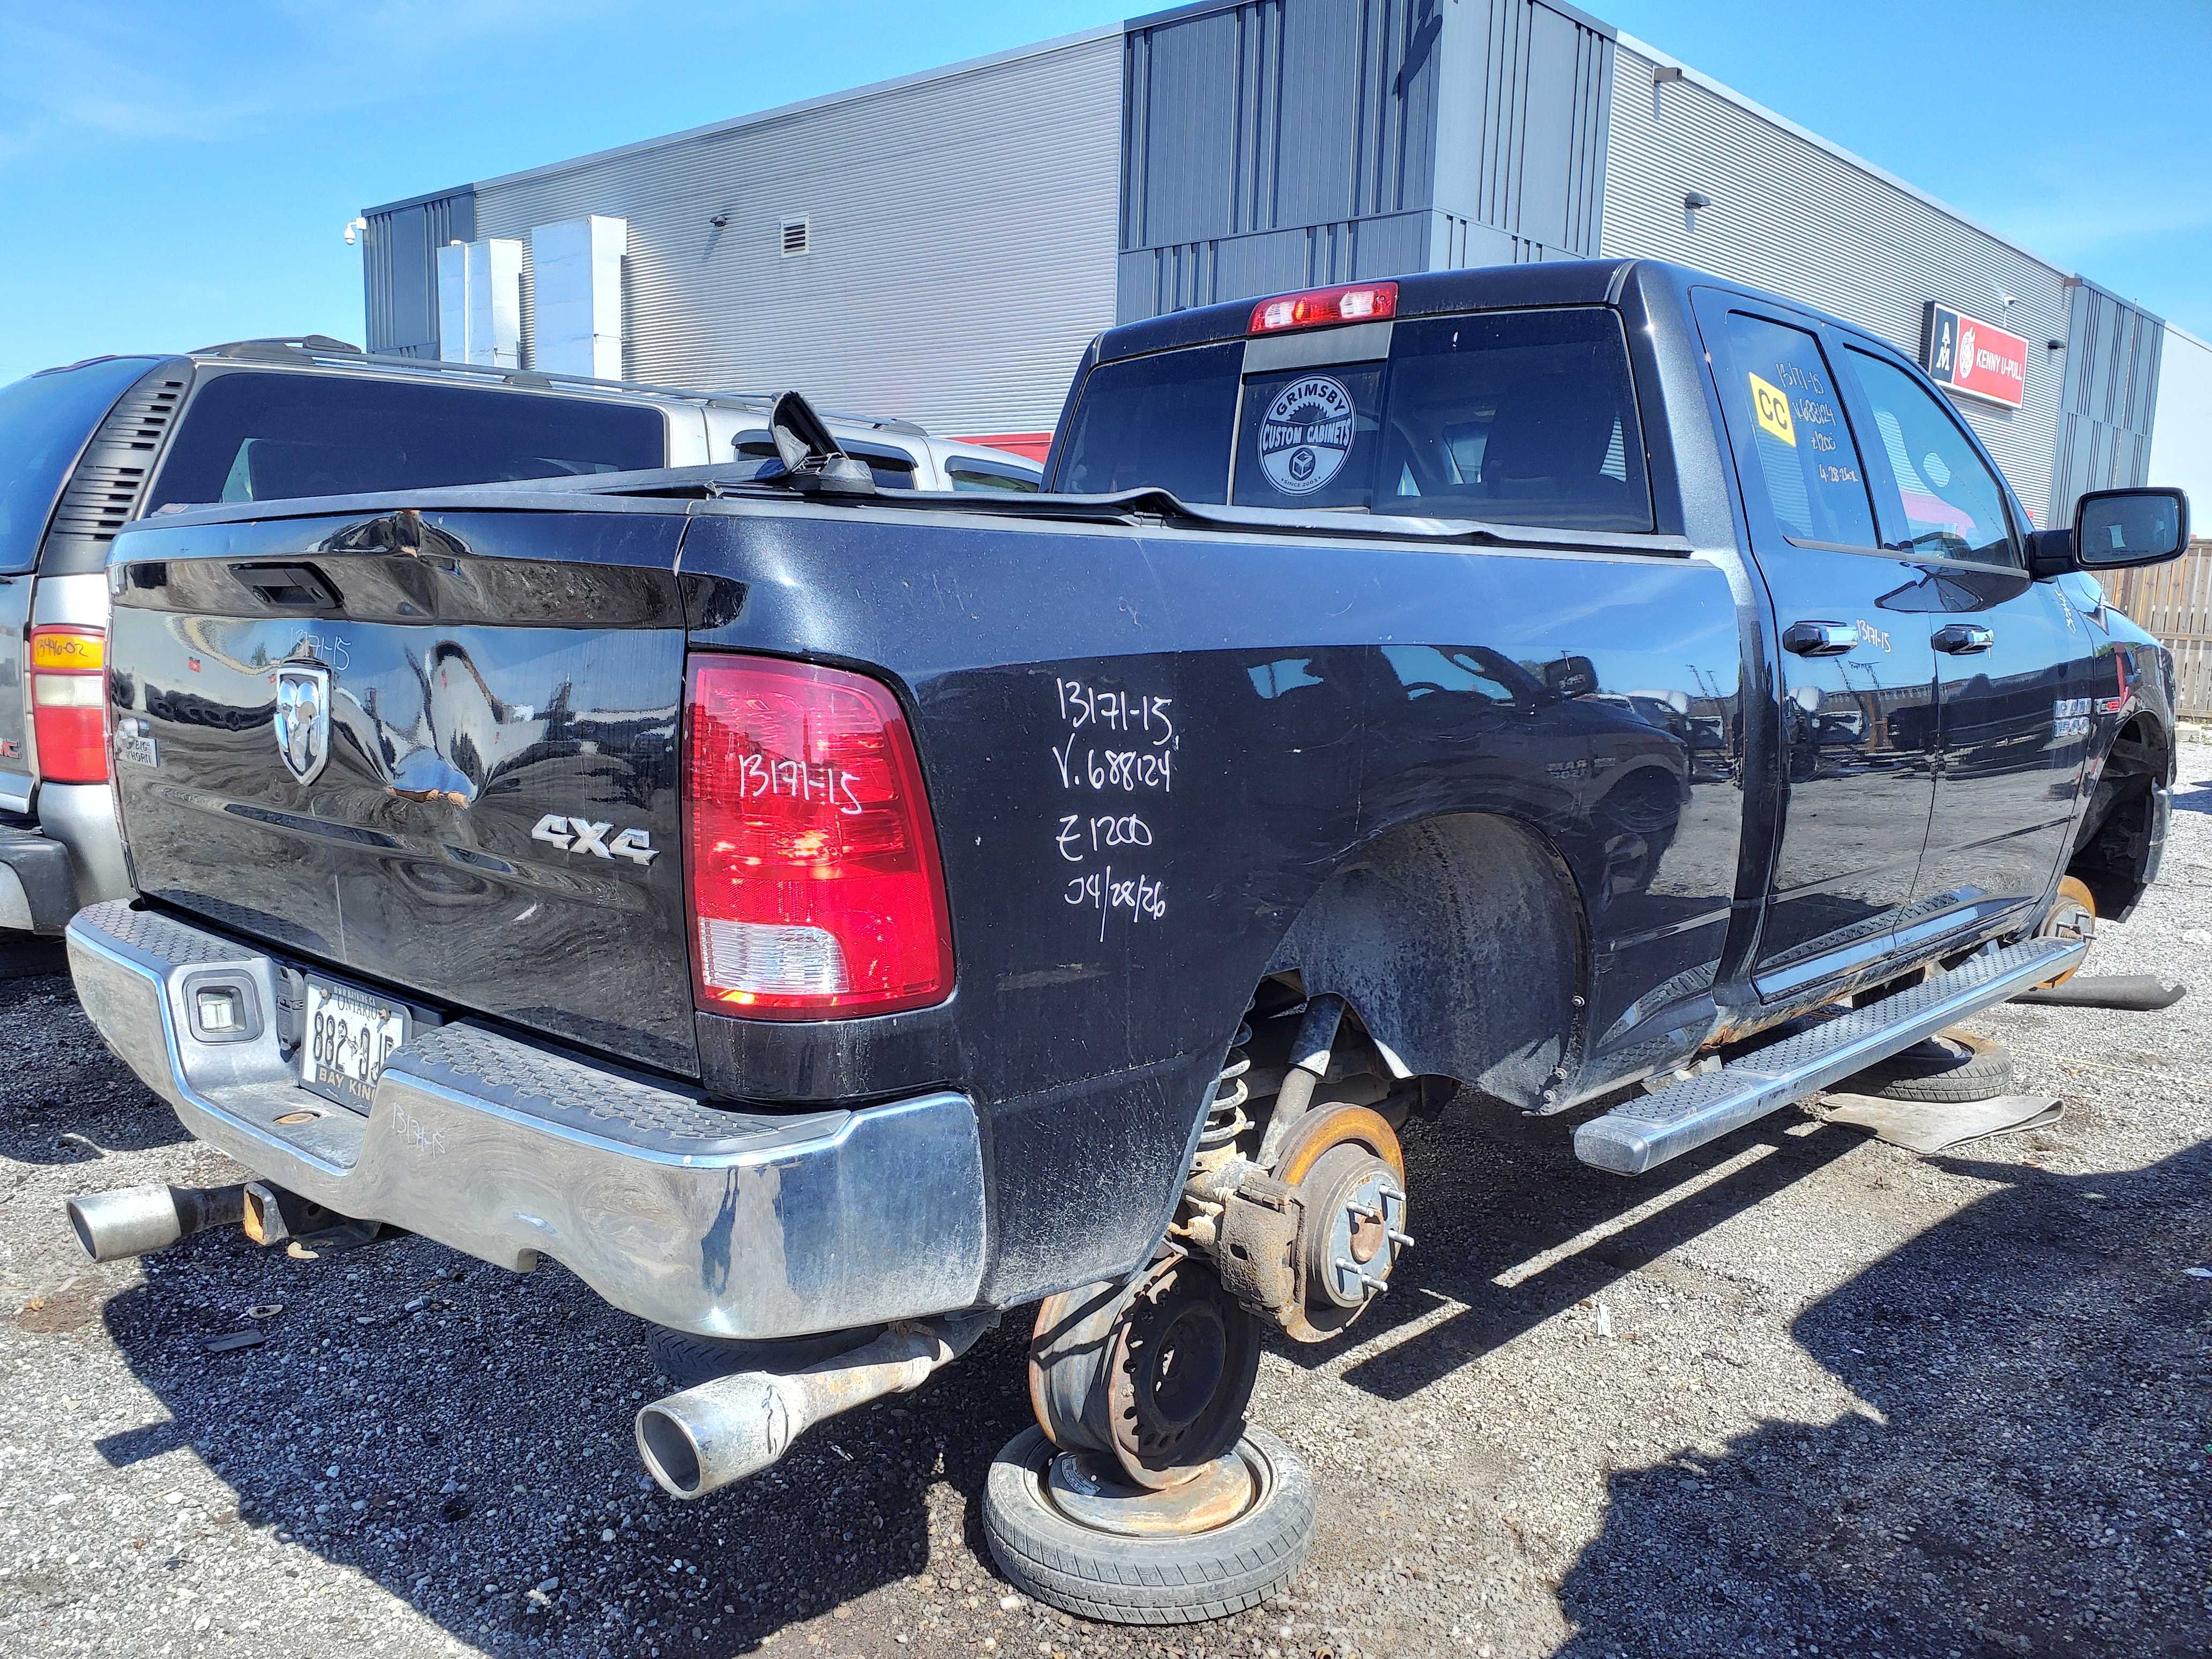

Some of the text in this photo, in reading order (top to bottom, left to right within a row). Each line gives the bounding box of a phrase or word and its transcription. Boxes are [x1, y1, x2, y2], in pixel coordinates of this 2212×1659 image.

[1976, 348, 2022, 381] KENNY U-PULL
[1276, 384, 1346, 415] GRIMSBY
[1758, 388, 1788, 430] CC
[1263, 418, 1352, 451] CUSTOM CABINETS
[289, 626, 352, 670] 13171-15
[1056, 677, 1173, 745] 13171-15
[2053, 698, 2091, 718] RAM
[2053, 716, 2090, 737] 1500
[131, 751, 152, 764] HORN
[136, 740, 149, 751] BIG
[738, 754, 862, 815] 13171-15
[338, 995, 377, 1021] ONTARIO
[319, 1067, 376, 1101] BAY KIN
